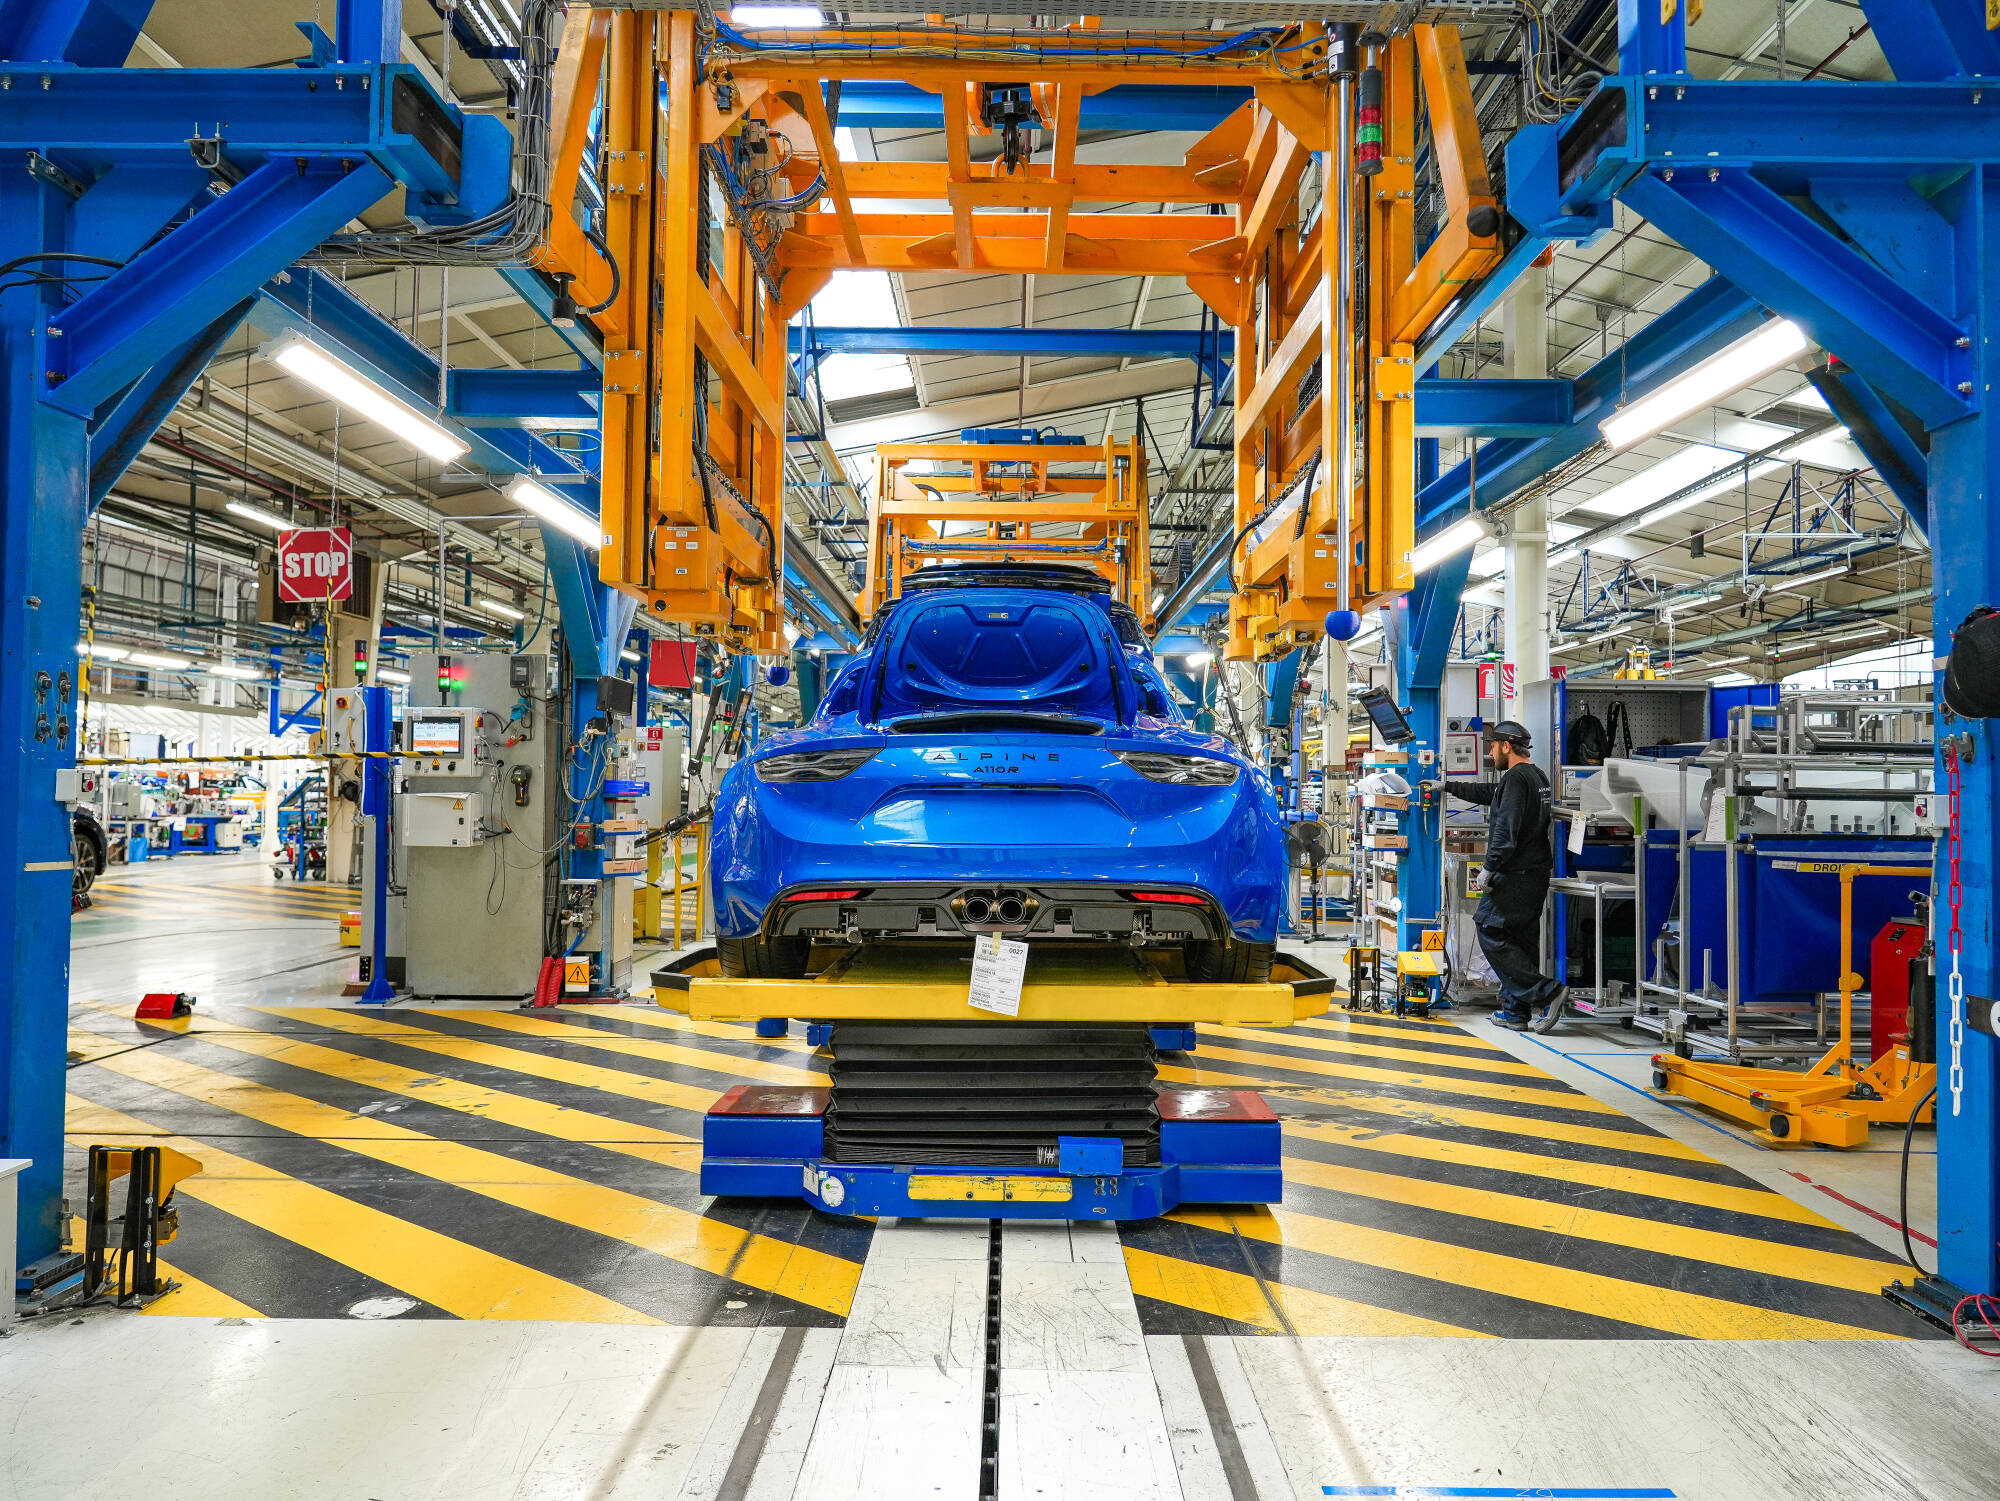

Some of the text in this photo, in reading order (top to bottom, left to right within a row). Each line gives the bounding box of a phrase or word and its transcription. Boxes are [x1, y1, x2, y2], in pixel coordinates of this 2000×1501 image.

[604, 535, 610, 544] 1
[1405, 552, 1410, 561] 1
[284, 551, 346, 578] STOP
[933, 752, 1060, 761] ALPINE
[973, 765, 1019, 774] A110R
[1008, 947, 1024, 956] 0027
